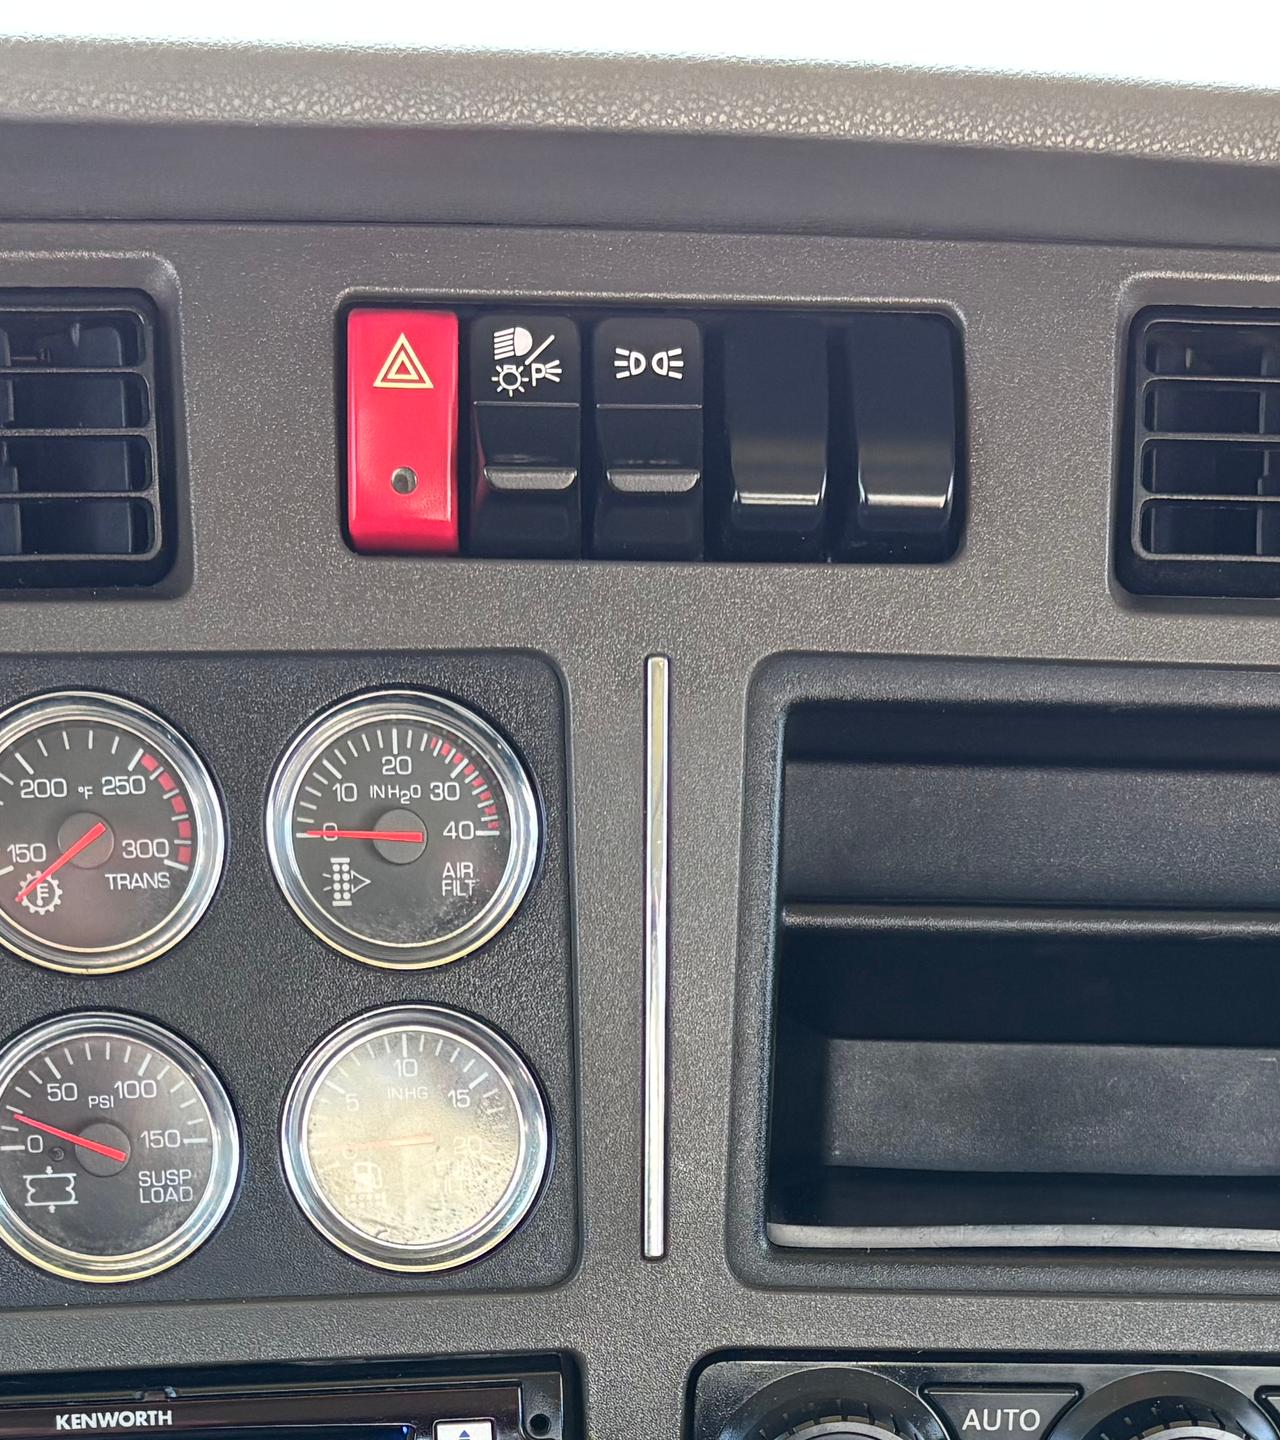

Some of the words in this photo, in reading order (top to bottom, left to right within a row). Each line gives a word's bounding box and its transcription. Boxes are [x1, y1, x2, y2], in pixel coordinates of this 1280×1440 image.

[382, 756, 412, 775] 20
[20, 779, 67, 798] 200
[102, 776, 146, 795] 250
[332, 783, 357, 802] 10
[430, 782, 460, 801] 30
[443, 821, 475, 840] 40
[7, 843, 46, 863] 150
[122, 839, 169, 859] 300
[442, 862, 474, 878] AIR
[105, 872, 170, 890] TRANS
[442, 880, 475, 896] FILT
[393, 1059, 418, 1077] 10
[47, 1082, 78, 1101] 50
[114, 1080, 157, 1099] 100
[448, 1090, 470, 1108] 15
[88, 1095, 114, 1109] PSI
[345, 1093, 360, 1112] 5
[27, 1135, 44, 1153] 0
[140, 1129, 181, 1149] 150
[139, 1170, 192, 1186] SUSP
[139, 1186, 194, 1203] LOAD
[56, 1411, 173, 1431] KENWORTH
[961, 1408, 1041, 1432] AUTO
